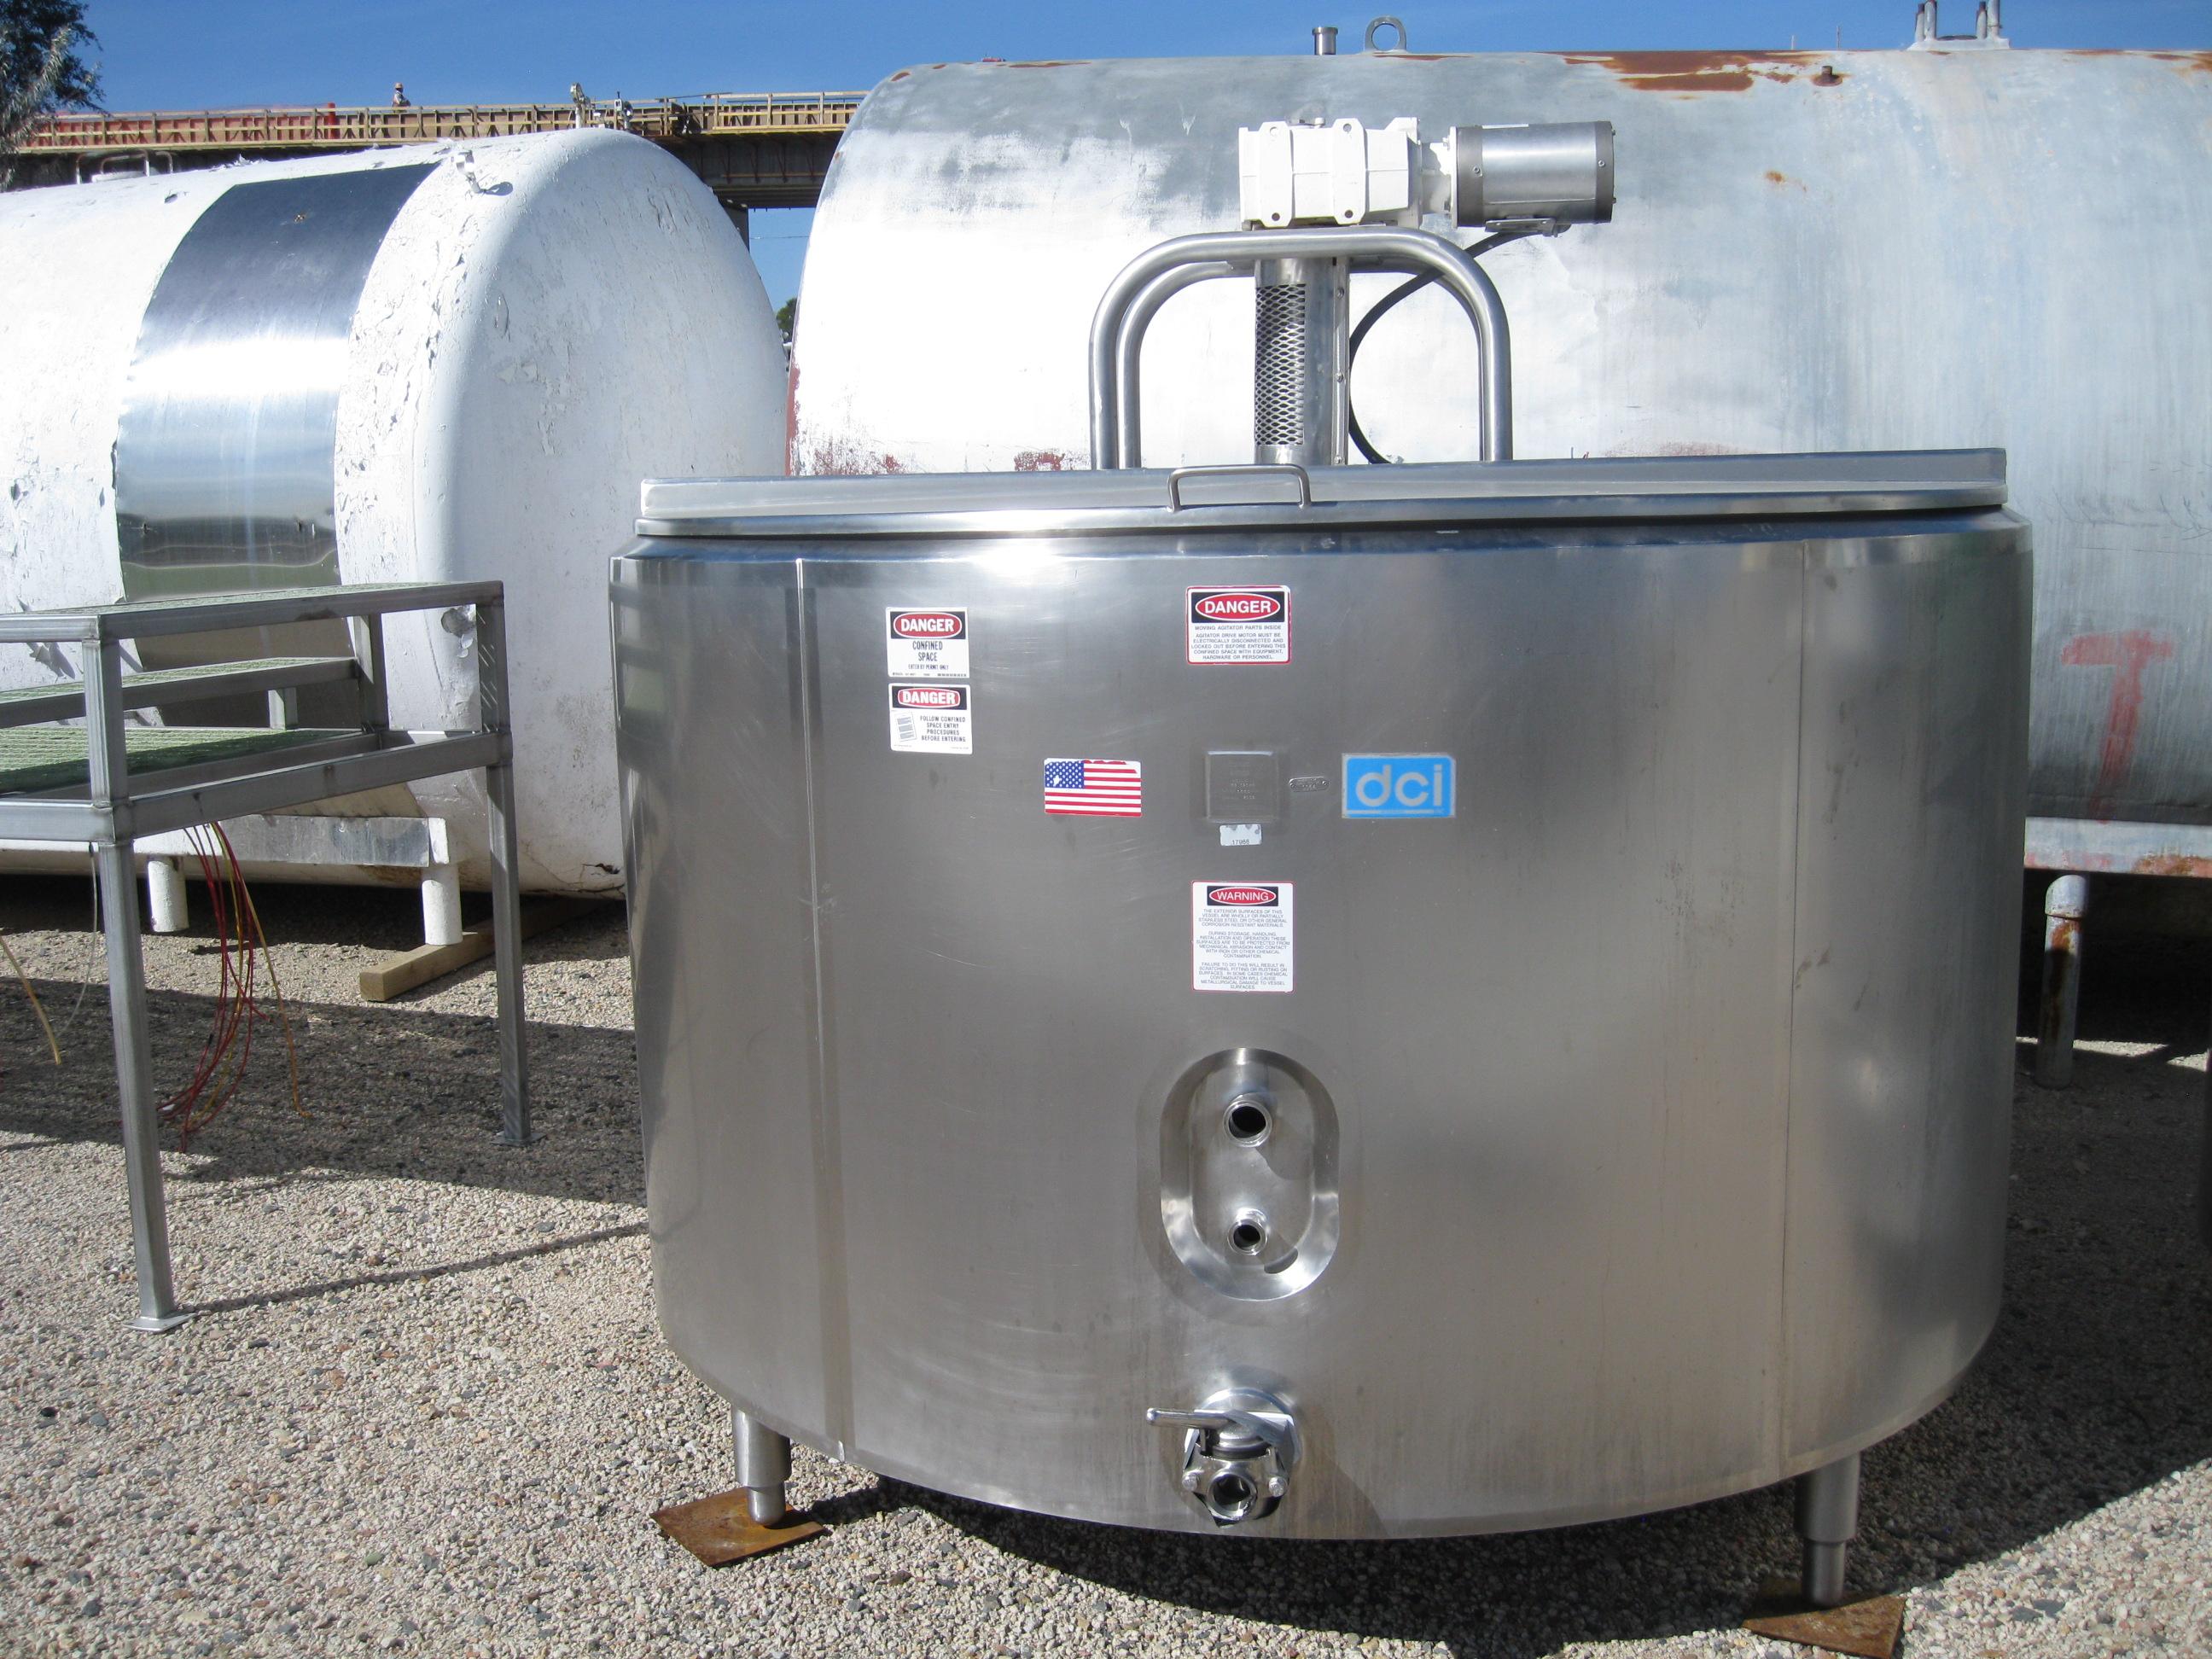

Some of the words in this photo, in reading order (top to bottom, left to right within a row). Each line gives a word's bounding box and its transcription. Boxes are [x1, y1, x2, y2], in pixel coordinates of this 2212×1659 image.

[1204, 601, 1272, 613] DANGER
[900, 619, 954, 632] DANGER
[912, 641, 943, 650] CONFINED
[918, 652, 938, 661] SPACE
[902, 691, 956, 704] DANGER
[1355, 765, 1442, 806] dci
[1216, 892, 1269, 900] WARNING
